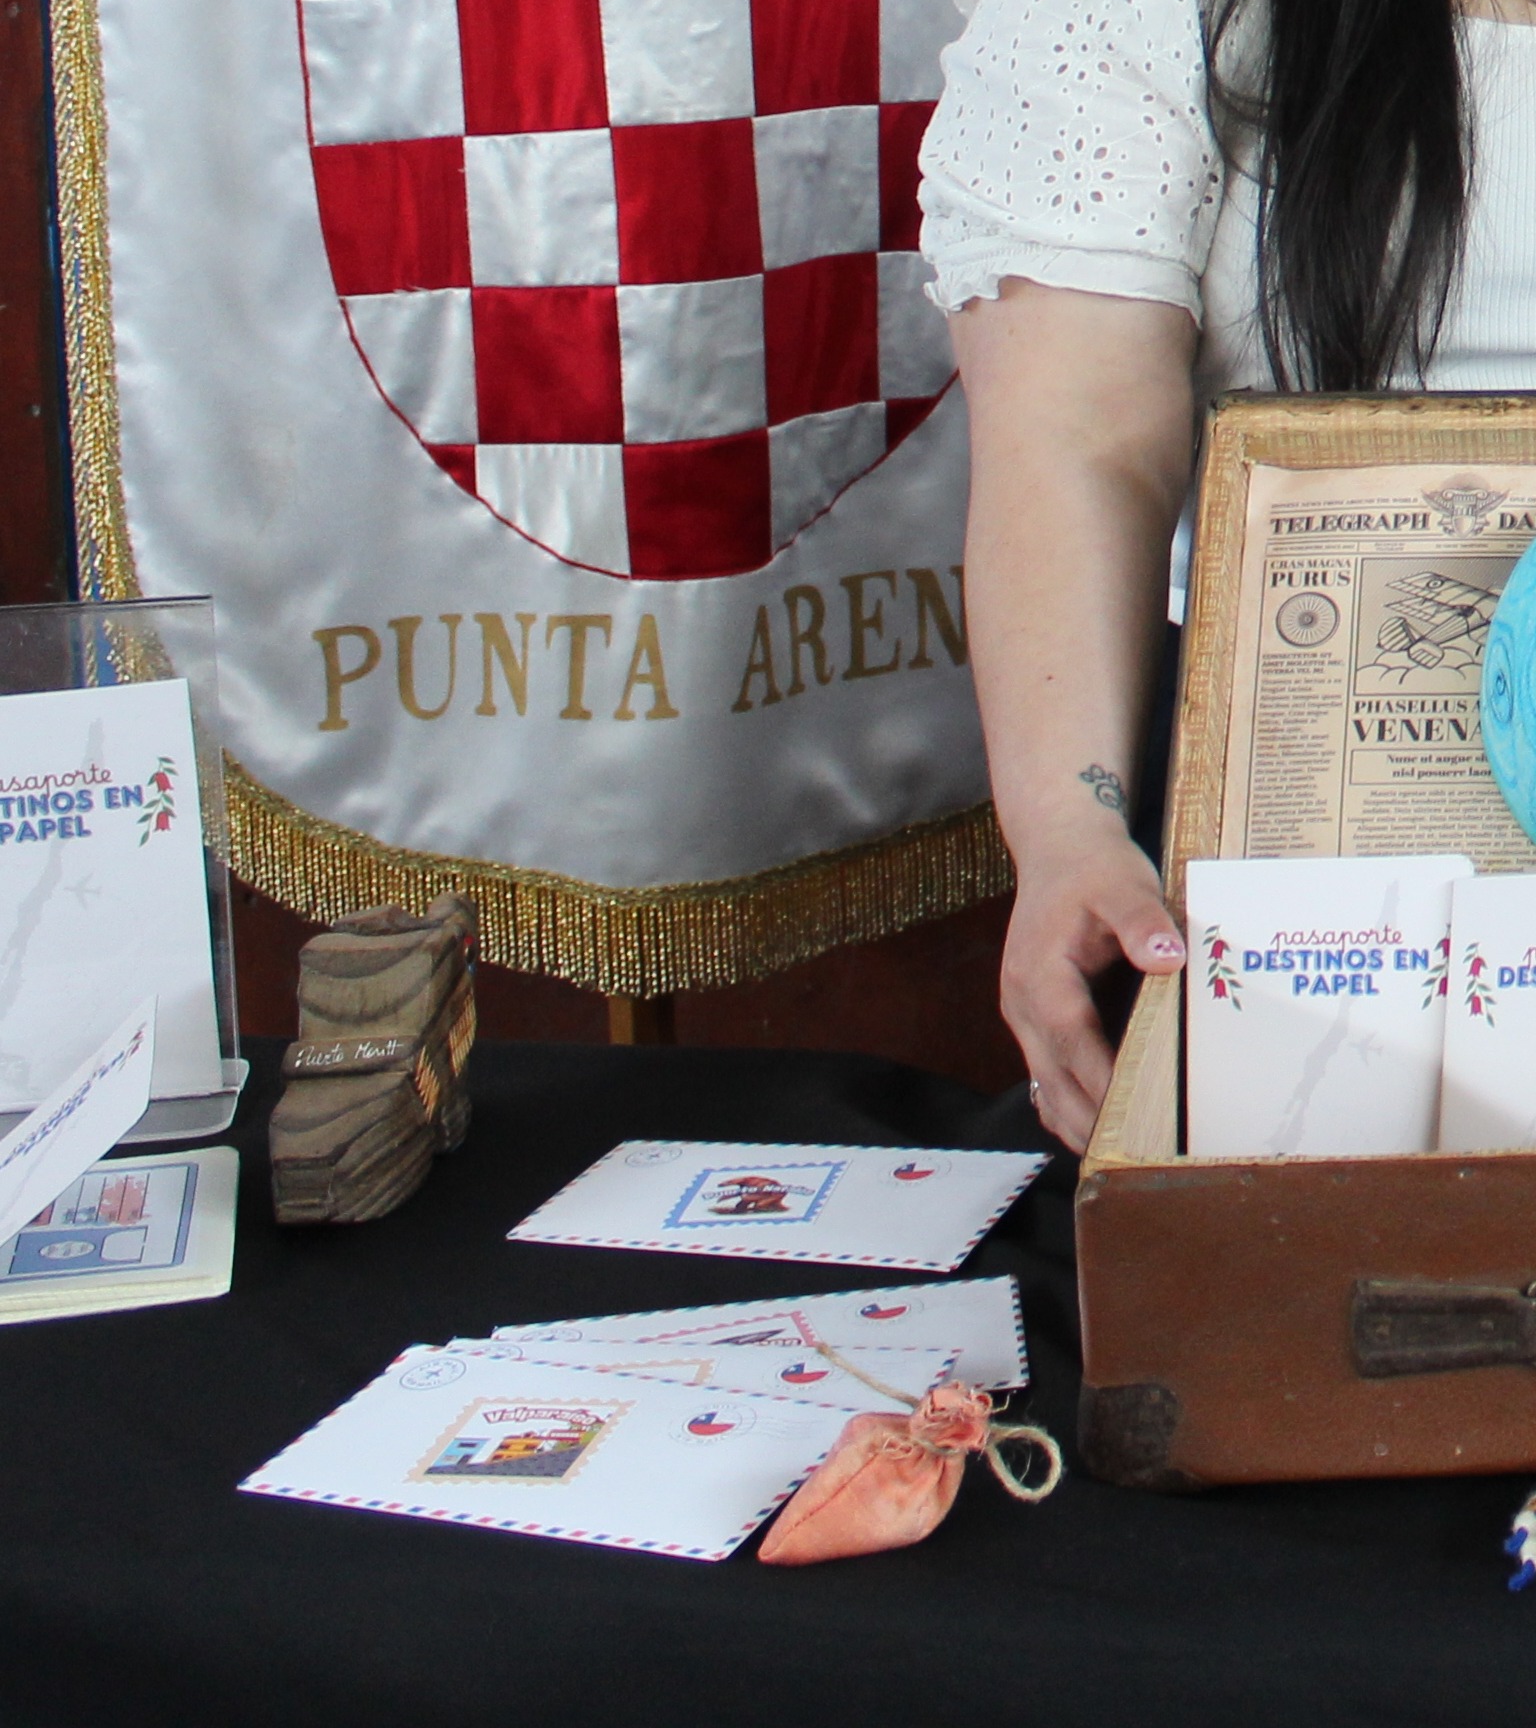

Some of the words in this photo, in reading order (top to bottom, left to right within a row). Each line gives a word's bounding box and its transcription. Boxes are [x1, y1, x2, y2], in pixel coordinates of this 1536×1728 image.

[1271, 511, 1431, 536] TELEGRAPH
[1270, 559, 1304, 569] CRAS
[1305, 558, 1352, 568] MAGNA
[1270, 569, 1352, 588] PURUS
[311, 612, 680, 732] PUNTA
[729, 565, 970, 715] AREN
[1353, 699, 1468, 715] PHASELLUS
[1386, 754, 1417, 763] Nunc
[1435, 755, 1473, 765] augue
[1417, 768, 1467, 780] posuere
[1469, 767, 1492, 777] laor
[0, 789, 95, 819] TINOS
[103, 784, 144, 810] EN
[0, 815, 92, 846] PAPEL
[1270, 924, 1404, 954] pasaporte
[1242, 948, 1384, 972] DESTINOS
[1393, 948, 1430, 971] EN
[1291, 973, 1381, 997] PAPEL
[294, 1042, 344, 1068] Puerto
